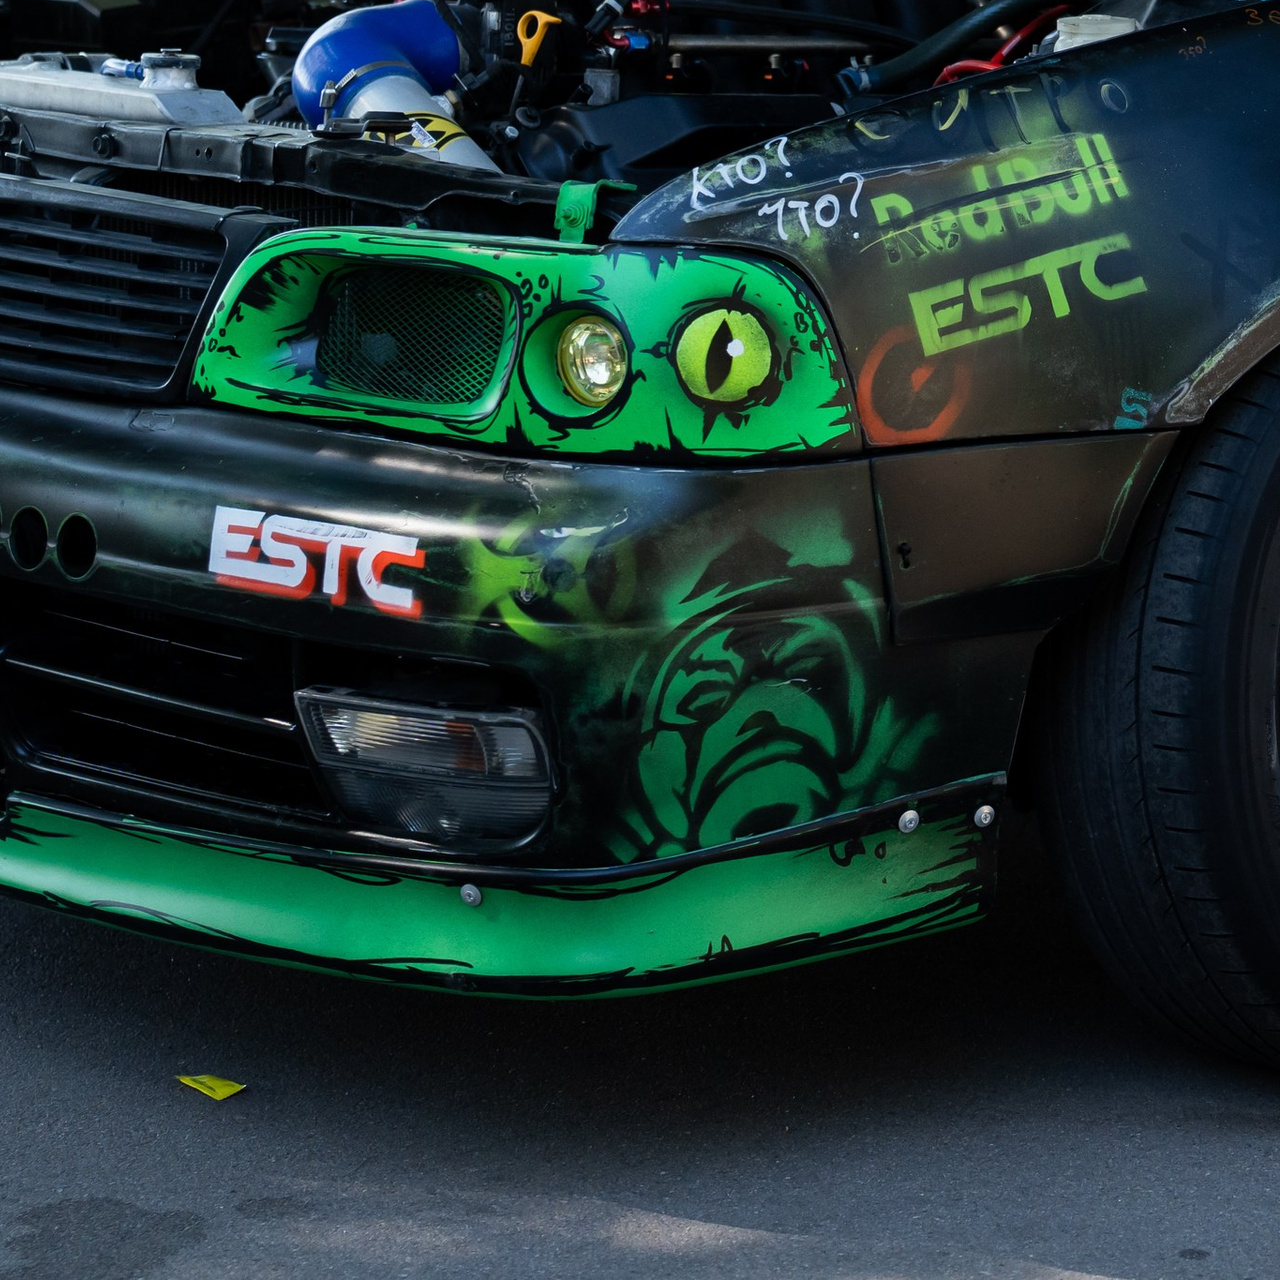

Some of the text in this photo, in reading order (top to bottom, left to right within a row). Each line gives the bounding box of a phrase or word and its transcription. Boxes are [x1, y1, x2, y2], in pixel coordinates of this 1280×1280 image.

[689, 136, 791, 211] КТО?
[758, 172, 864, 240] ЧТО?
[908, 232, 1148, 357] ESTC
[208, 505, 424, 617] ESTC
